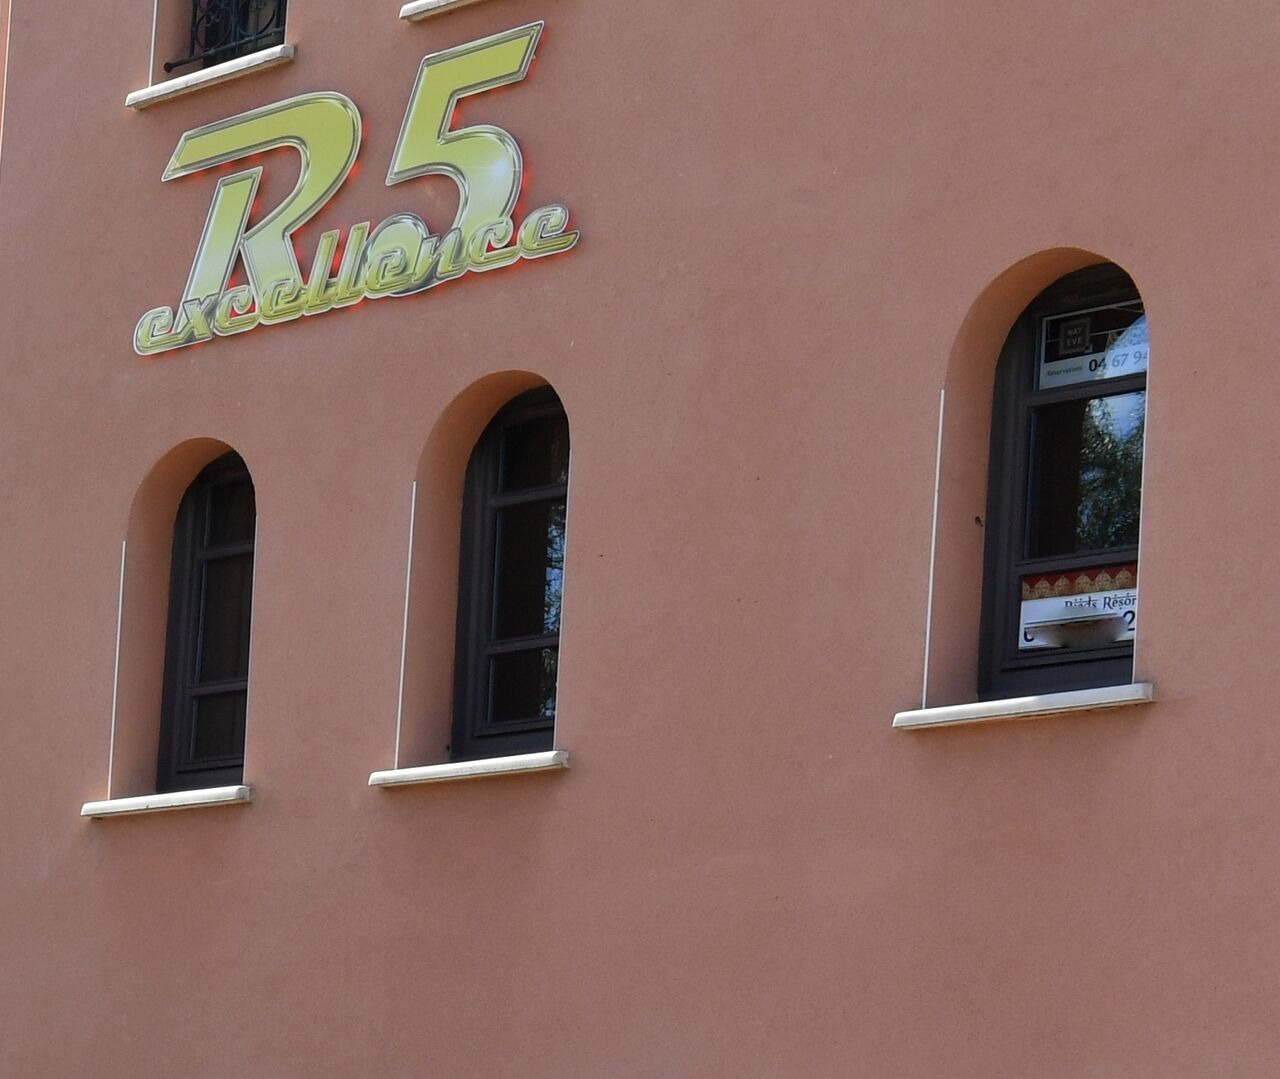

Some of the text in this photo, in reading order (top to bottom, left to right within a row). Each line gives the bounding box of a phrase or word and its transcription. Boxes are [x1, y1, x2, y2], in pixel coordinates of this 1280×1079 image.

[132, 203, 581, 356] excellence
[1089, 358, 1107, 372] 04
[1112, 353, 1128, 367] 67
